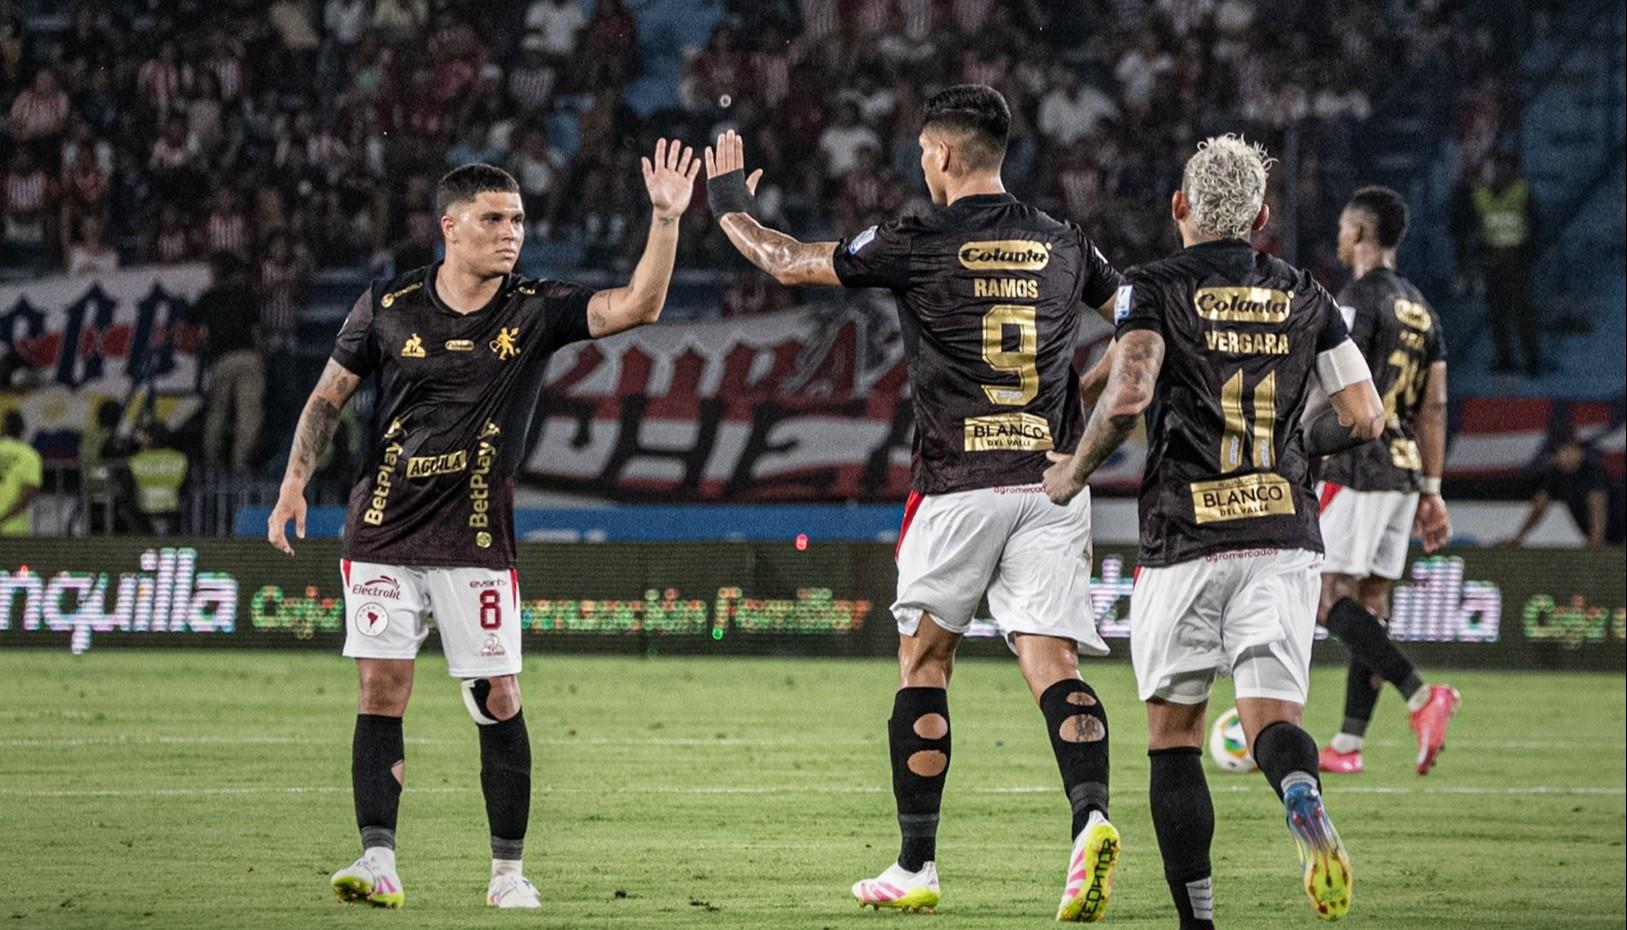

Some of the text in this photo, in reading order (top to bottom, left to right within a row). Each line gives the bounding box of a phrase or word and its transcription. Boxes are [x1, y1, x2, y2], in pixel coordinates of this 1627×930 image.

[974, 278, 1039, 298] RAMOS
[1197, 293, 1287, 314] Colanta
[1205, 331, 1289, 354] VERGARA
[981, 304, 1039, 406] 9
[974, 424, 1044, 440] BLANCO
[1221, 369, 1276, 473] 11
[363, 441, 404, 526] BetPlay
[469, 441, 496, 528] BetPlay
[1203, 486, 1283, 507] BLANCO
[1220, 505, 1270, 517] DEL VALLE
[352, 584, 401, 600] Electrolit
[480, 589, 502, 631] 8
